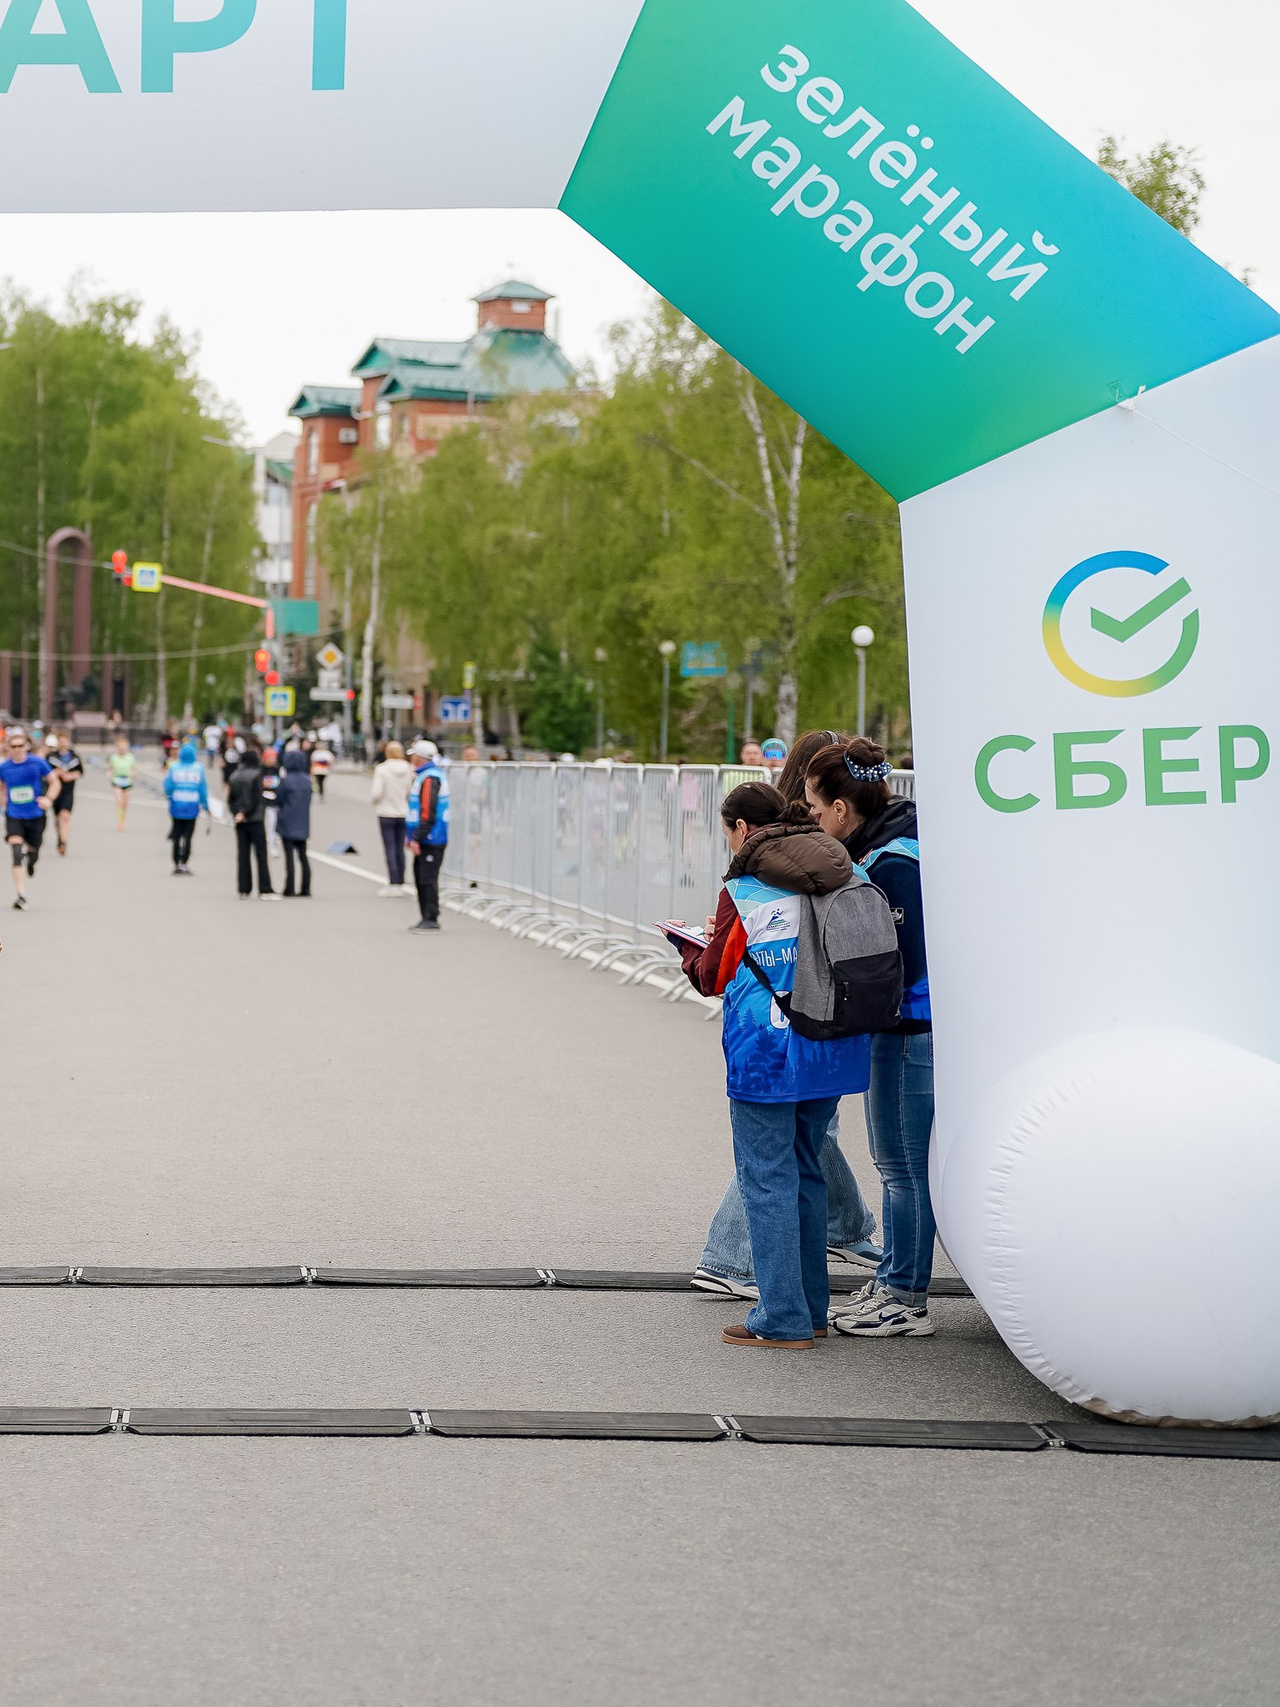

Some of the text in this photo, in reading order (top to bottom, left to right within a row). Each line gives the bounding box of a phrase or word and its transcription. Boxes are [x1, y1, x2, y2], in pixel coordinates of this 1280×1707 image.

[705, 95, 996, 355] марафон
[760, 44, 1060, 301] зелёный
[974, 724, 1271, 814] СБЕР
